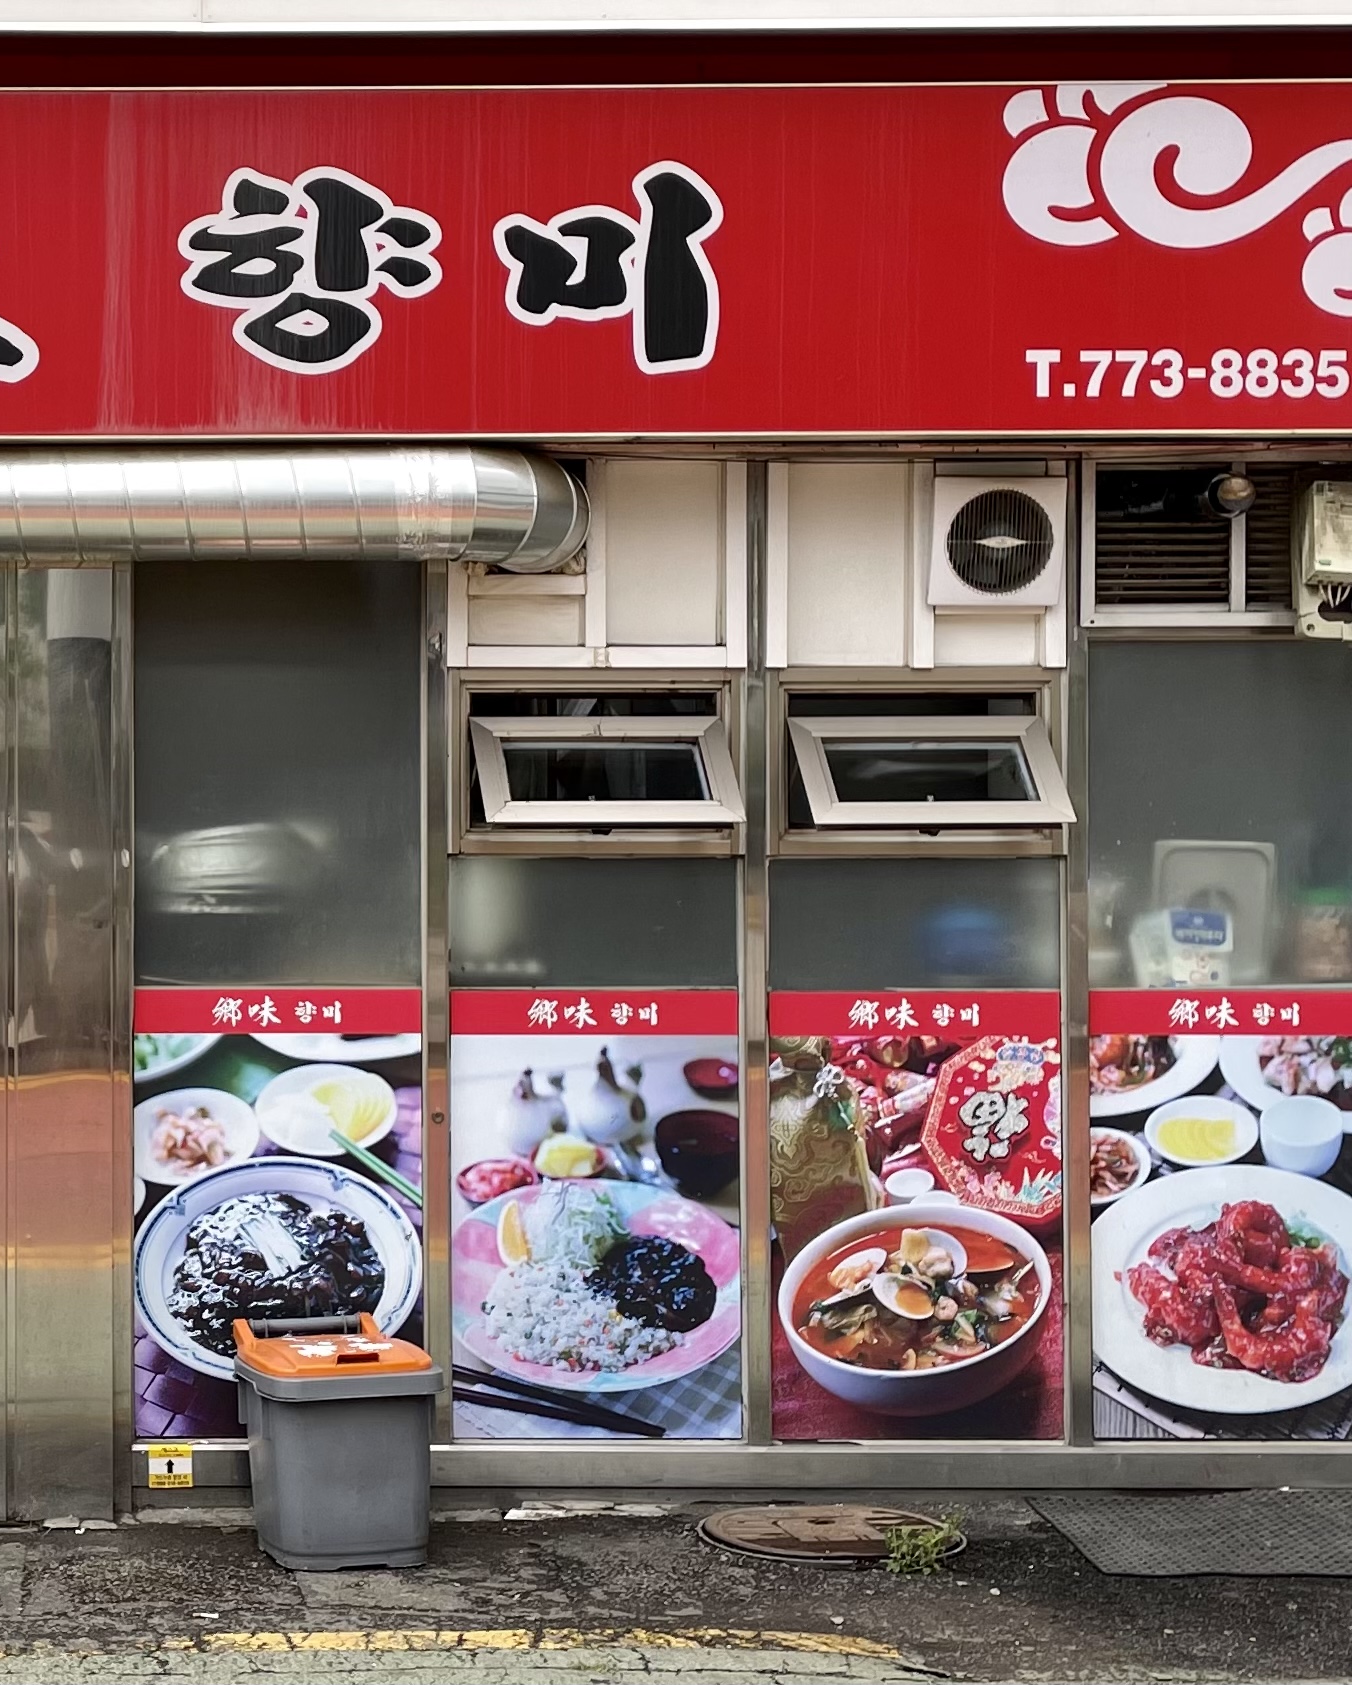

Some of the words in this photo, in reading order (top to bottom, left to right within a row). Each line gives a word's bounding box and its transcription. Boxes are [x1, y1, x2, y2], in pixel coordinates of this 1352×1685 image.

[178, 161, 723, 375] 향미
[1026, 349, 1351, 398] T.773-8835
[294, 1000, 342, 1024] 향미
[610, 1002, 658, 1026] 향미
[931, 1002, 980, 1027] 향미
[1252, 1002, 1300, 1027] 향미
